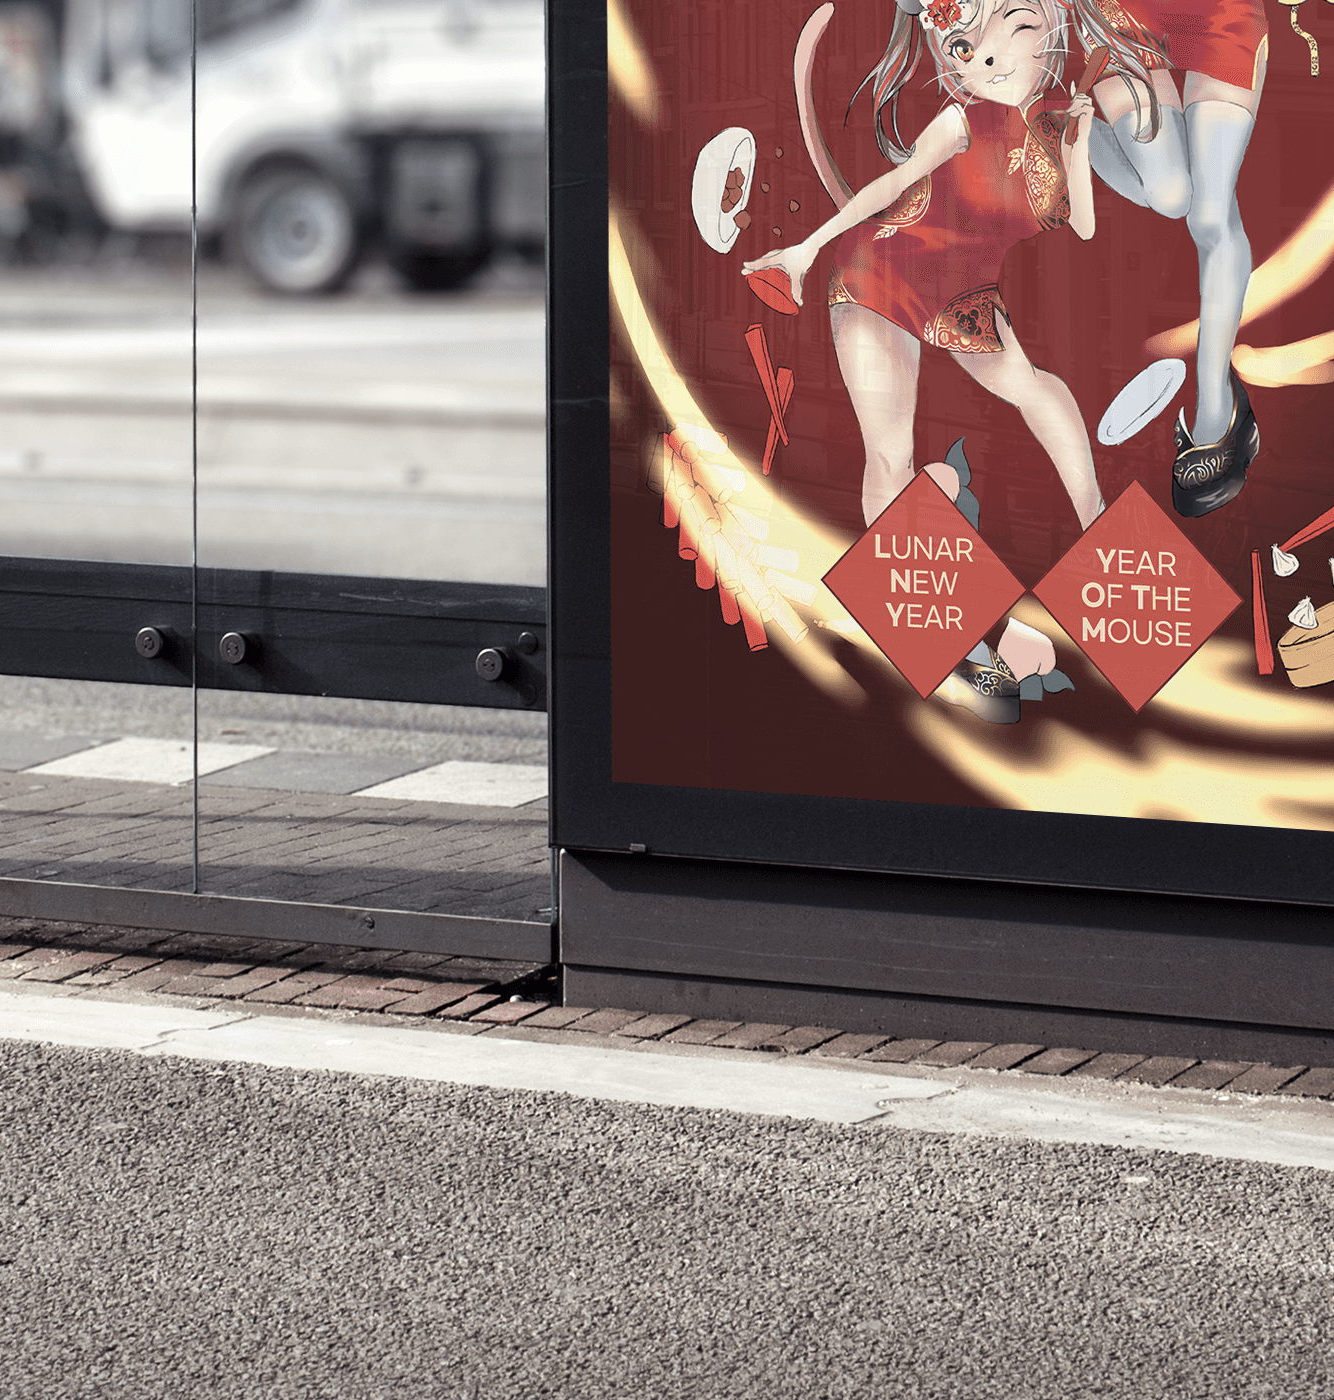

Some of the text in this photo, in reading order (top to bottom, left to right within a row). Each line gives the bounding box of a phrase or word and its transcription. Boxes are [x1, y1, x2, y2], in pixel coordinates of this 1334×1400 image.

[875, 534, 974, 562] LUNAR
[1095, 548, 1176, 577] YEAR
[890, 568, 959, 596] NEW
[1081, 582, 1192, 612] OF THE
[885, 602, 964, 630] YEAR
[1081, 617, 1192, 647] MOUSE
